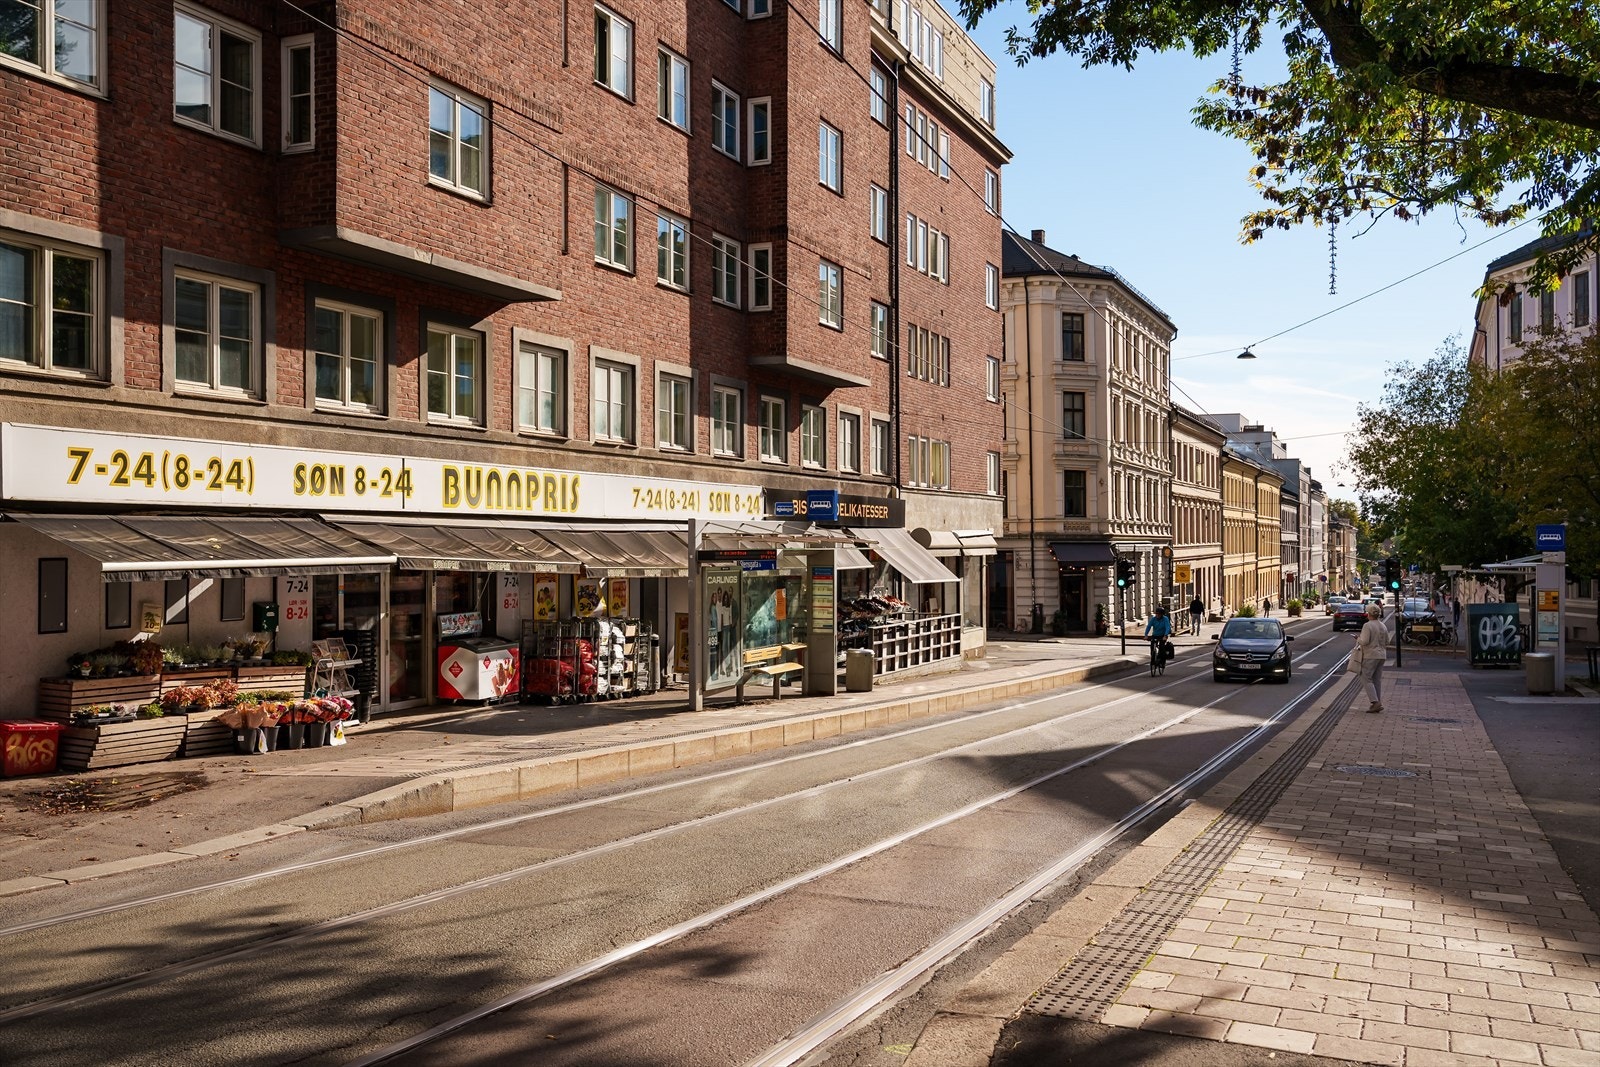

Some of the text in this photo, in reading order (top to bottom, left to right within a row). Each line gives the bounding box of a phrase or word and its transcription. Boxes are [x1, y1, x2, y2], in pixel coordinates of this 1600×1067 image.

[67, 446, 414, 499] 7-24(8-24) SØN 8-24
[442, 465, 581, 513] BUNNPRIS
[633, 487, 761, 514] 7-24(8-24) SØN 8-24
[286, 580, 309, 593] 7-24
[707, 576, 738, 584] CARLINGS
[286, 606, 308, 620] 8-24
